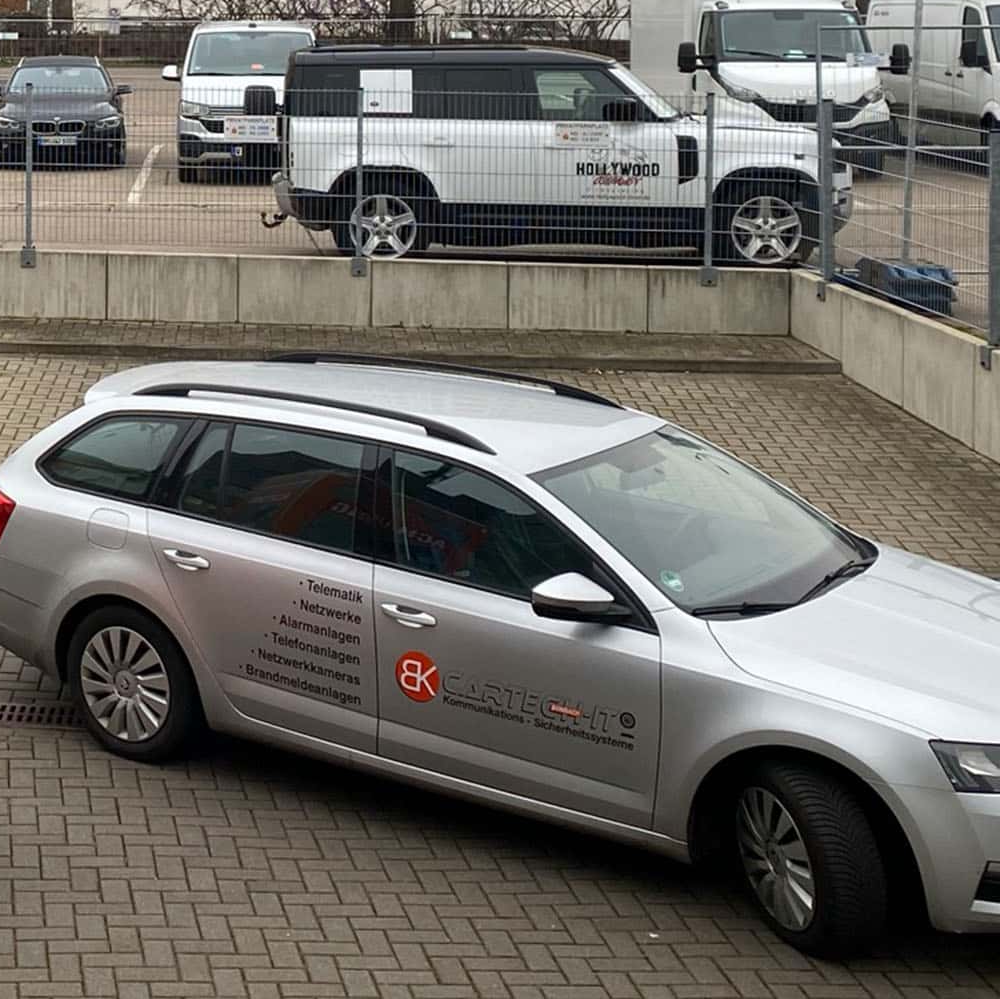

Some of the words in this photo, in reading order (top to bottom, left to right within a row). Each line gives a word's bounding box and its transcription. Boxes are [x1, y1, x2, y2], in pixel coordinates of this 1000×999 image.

[576, 162, 660, 176] HOLLYWOOD
[306, 579, 363, 604] Telematik
[299, 599, 362, 625] Netzwerke
[279, 614, 361, 646] Alarmanlagen
[271, 631, 361, 666] Telefonanlagen
[257, 647, 361, 686] Netzwerkkameras
[245, 663, 361, 705] Brandmeldeanlagen
[443, 696, 525, 724] Kommunikations
[534, 717, 635, 751] Sicherheitssysteme
